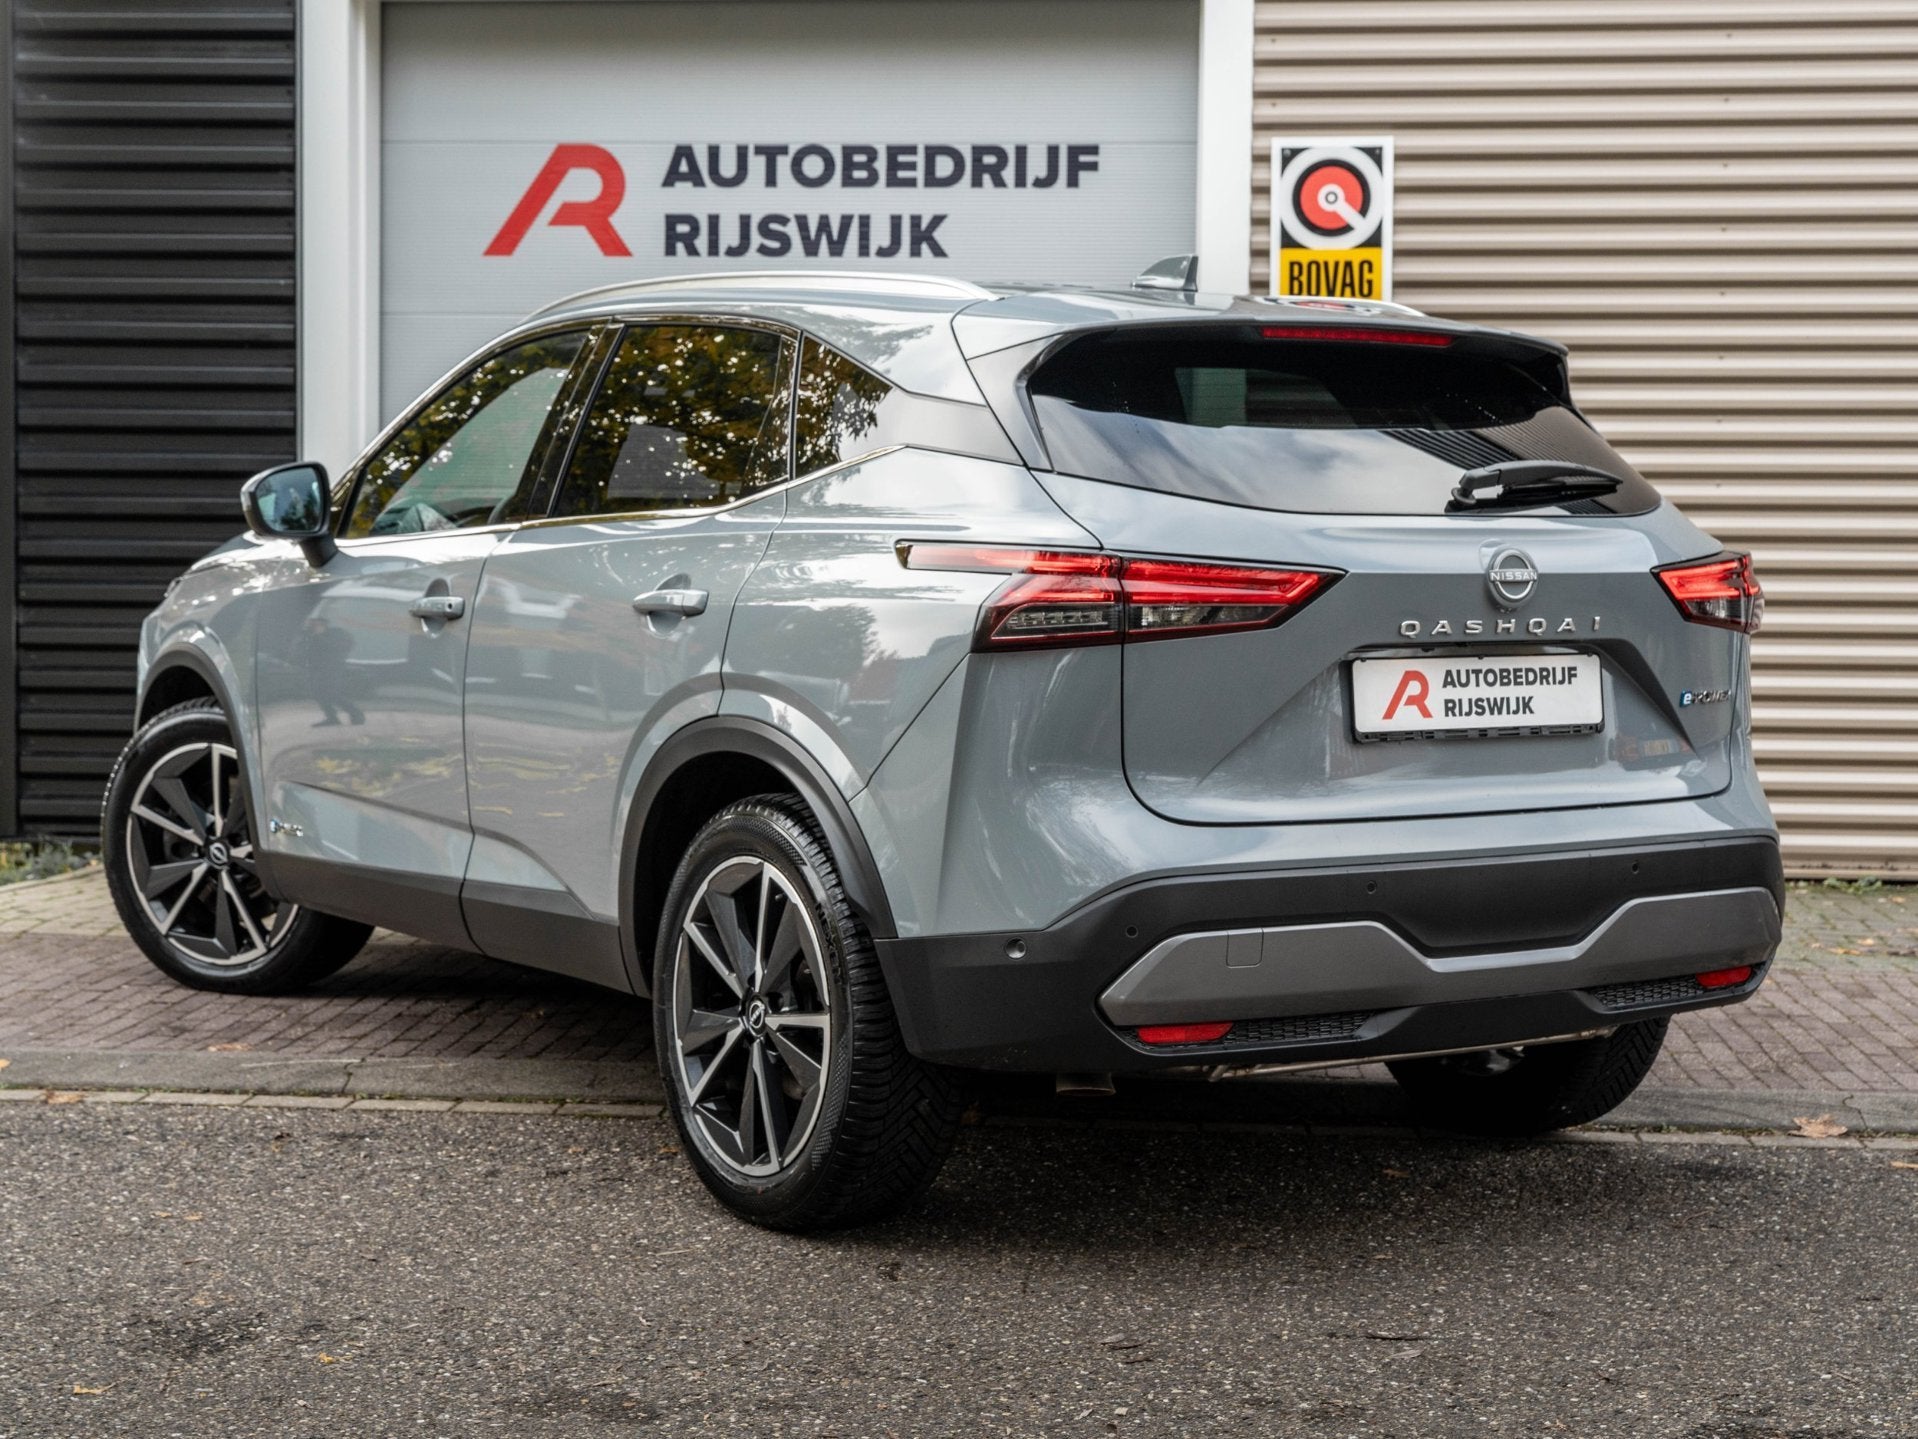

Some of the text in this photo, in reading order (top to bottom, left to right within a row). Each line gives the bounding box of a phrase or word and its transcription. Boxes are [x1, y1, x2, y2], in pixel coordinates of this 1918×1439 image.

[662, 143, 1100, 189] AUTOBEDRIJF
[664, 213, 949, 258] RIJSWIJK
[1288, 259, 1374, 298] BOVAG
[1490, 571, 1537, 581] NISSAN
[1400, 616, 1600, 638] QASHQAI
[1442, 666, 1578, 688] AUTOBEDRIJF
[1444, 696, 1535, 718] RIJSWIJK
